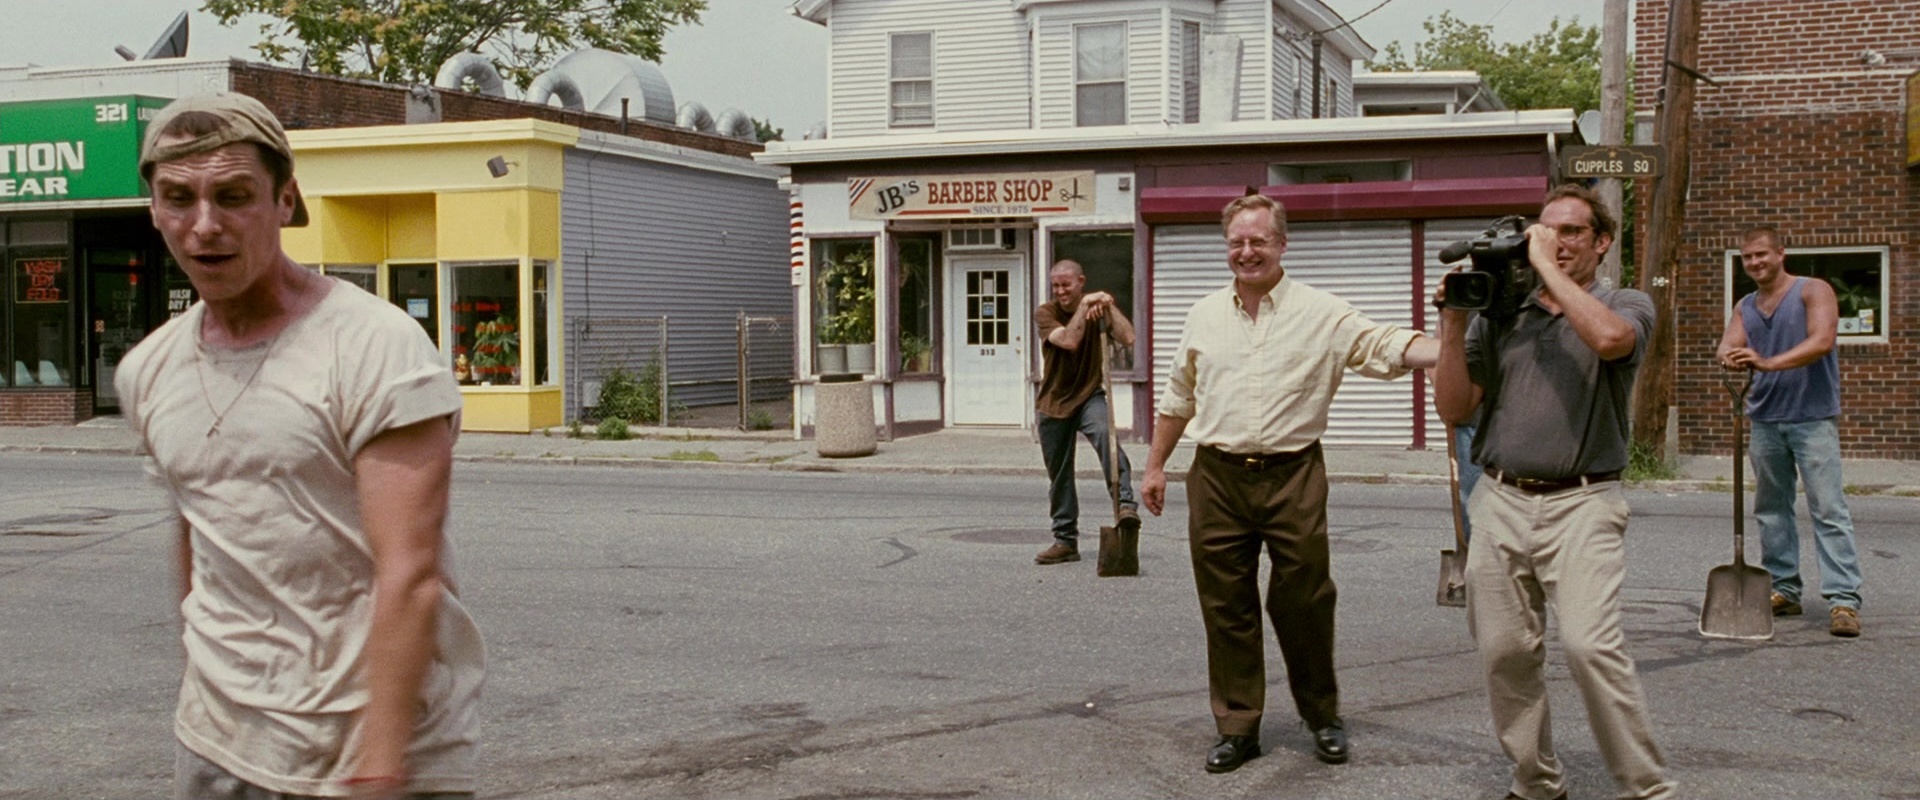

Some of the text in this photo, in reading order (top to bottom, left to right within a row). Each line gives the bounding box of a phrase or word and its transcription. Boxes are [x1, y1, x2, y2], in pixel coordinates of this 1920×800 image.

[95, 103, 128, 122] 321
[1575, 160, 1649, 173] CUPPLES SQ
[928, 181, 998, 204] BARBER
[1003, 180, 1053, 202] SHOP
[973, 204, 1029, 215] SINCE 1975
[169, 288, 191, 299] WASH
[168, 300, 184, 310] DRY
